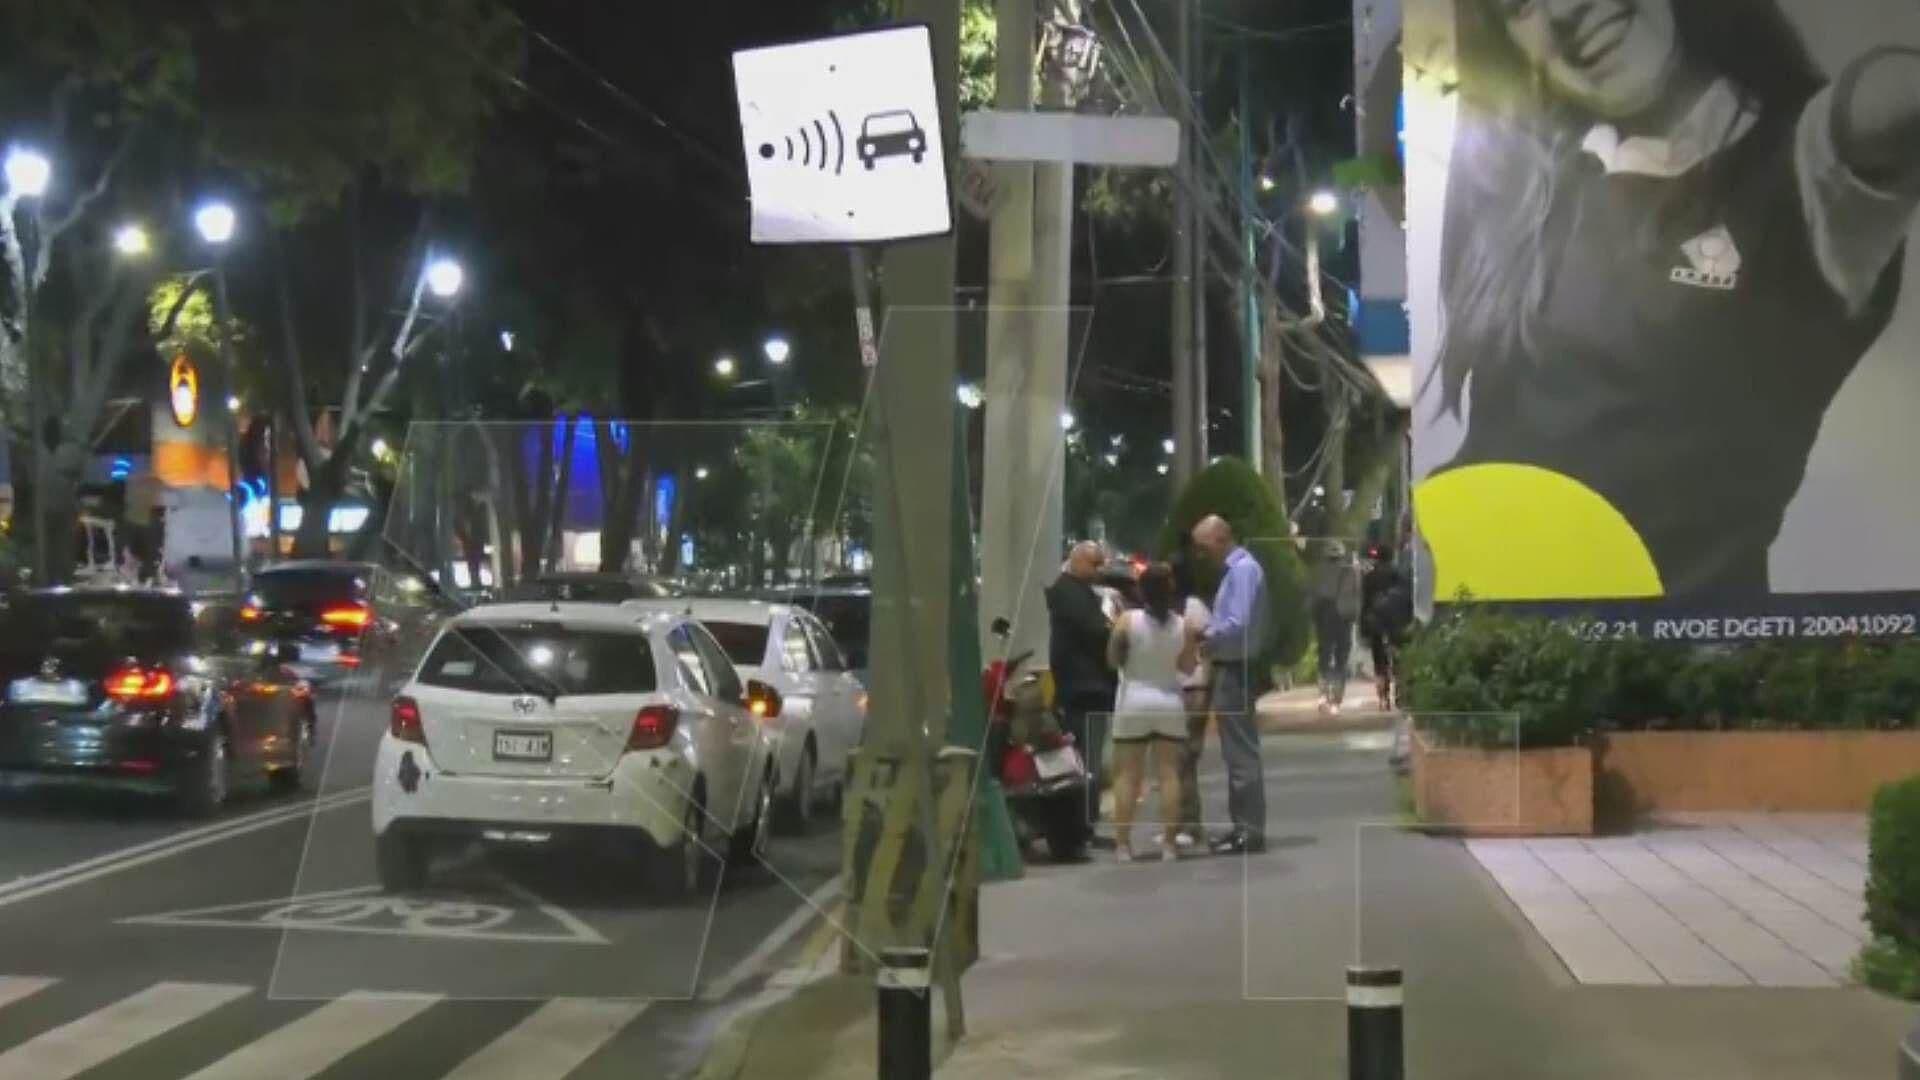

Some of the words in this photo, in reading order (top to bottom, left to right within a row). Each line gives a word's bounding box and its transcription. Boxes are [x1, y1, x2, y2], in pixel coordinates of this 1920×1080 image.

[1653, 618, 1719, 639] RVOE
[1724, 616, 1795, 637] DGETI
[1801, 614, 1916, 637] 20041092
